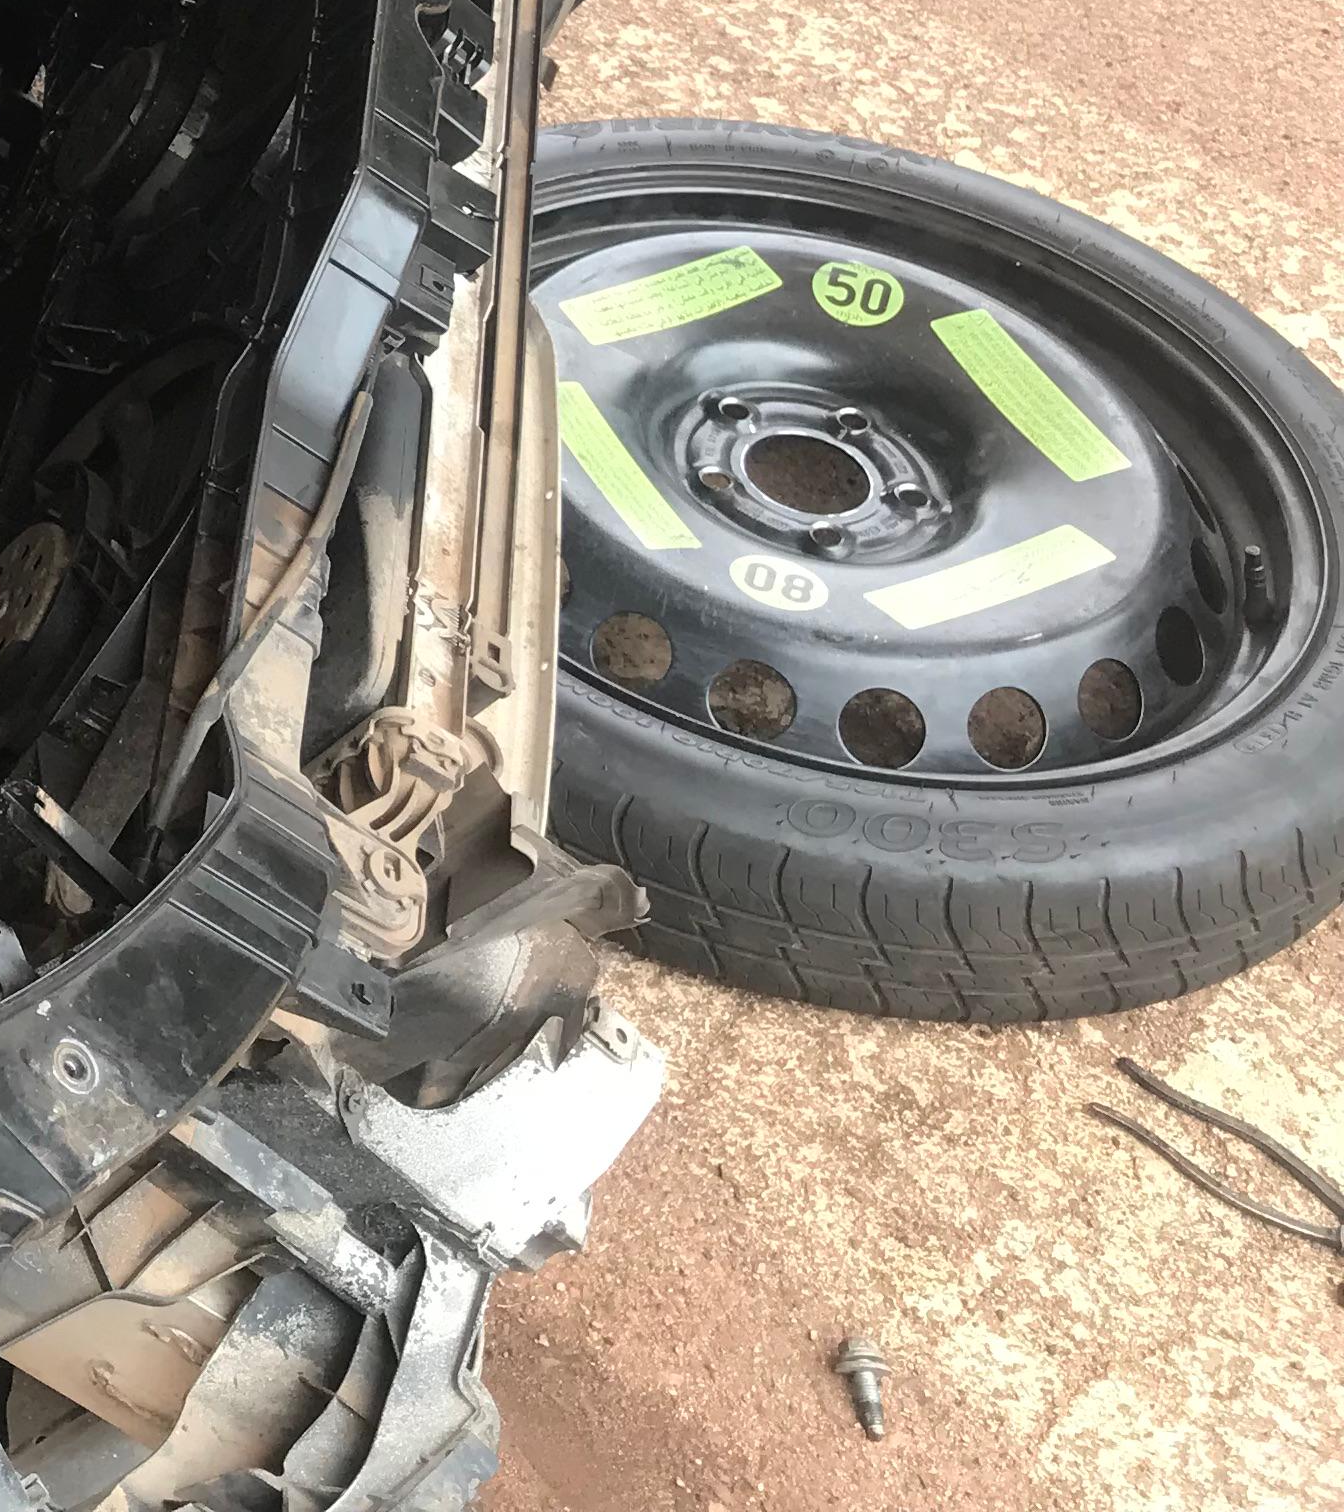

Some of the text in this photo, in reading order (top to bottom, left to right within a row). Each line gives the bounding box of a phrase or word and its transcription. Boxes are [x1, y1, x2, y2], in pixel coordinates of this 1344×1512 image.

[824, 266, 893, 316] 50
[743, 562, 814, 603] 80
[786, 798, 1067, 864] S300
